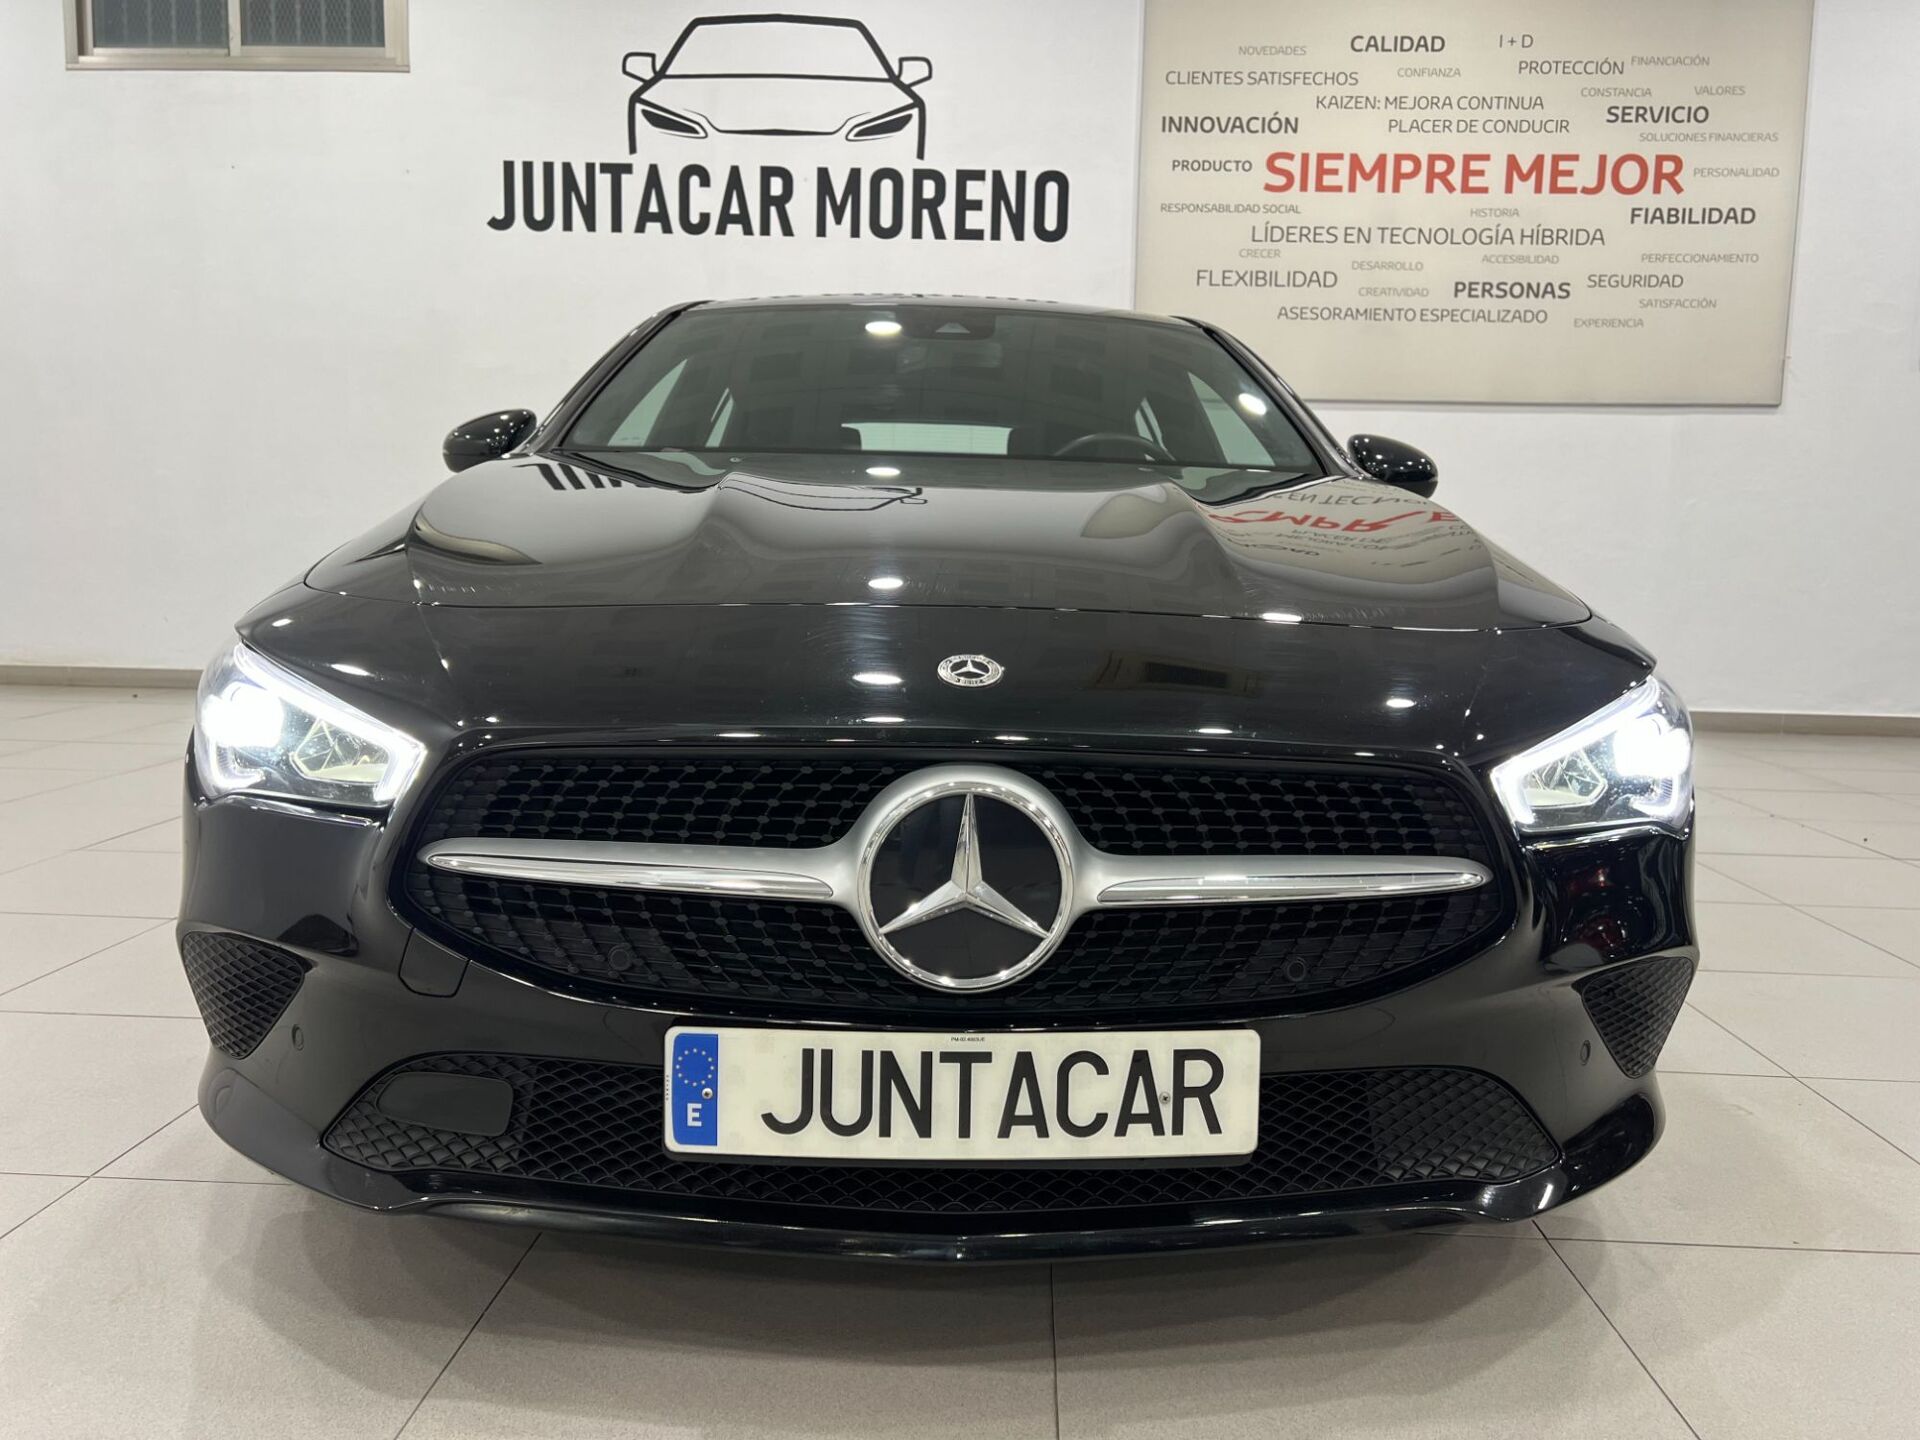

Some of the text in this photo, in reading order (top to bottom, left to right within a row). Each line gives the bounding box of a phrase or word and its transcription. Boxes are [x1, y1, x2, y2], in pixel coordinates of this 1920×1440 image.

[1350, 35, 1445, 53] CALIDAD
[1521, 34, 1533, 48] D
[1239, 45, 1306, 56] NOVEDADES
[1518, 57, 1624, 75] PROTECCIÓN
[1631, 55, 1710, 66] FINANCIACIÓN
[1166, 71, 1359, 86] CLIENTES SATISFECHOS
[1397, 67, 1461, 78] CONFIANZA
[1580, 87, 1652, 98] CONSTANCIA
[1694, 85, 1745, 96] VALORES
[1316, 95, 1544, 111] KAIZEN: MEJORA CONTINUA
[1606, 106, 1709, 124] SERVICIO
[1161, 112, 1298, 134] INNOVACIÓN
[1388, 119, 1570, 134] PLACER DE CONDUCIR
[1639, 132, 1779, 142] SOLUCIONES FINANCIERAS
[1172, 160, 1252, 172] PRODUCTO
[1693, 167, 1780, 178] PERSONALIDAD
[1263, 151, 1684, 196] SIEMPRE MEJOR
[486, 160, 1070, 243] JUNTACAR MORENO
[1160, 203, 1301, 215] RESPONSABILIDAD SOCIAL
[1470, 208, 1519, 217] HISTORIA
[1630, 207, 1756, 225] FIABILIDAD
[1251, 221, 1605, 246] LÍDERES EN TECNOLOGÍA HÍBRIDA
[1239, 249, 1281, 258] CRECER
[1481, 254, 1559, 264] ACCESIBILIDAD
[1641, 253, 1759, 263] PERFECCIONAMIENTO
[1351, 261, 1423, 271] DESARROLLO
[1196, 269, 1338, 288] FLEXIBILIDAD
[1587, 274, 1684, 289] SEGURIDAD
[1358, 287, 1429, 297] CREATIVIDAD
[1453, 281, 1571, 299] PERSONAS
[1639, 297, 1717, 309] SATISFACCIÓN
[1277, 306, 1548, 323] ASESORAMIENTO ESPECIALIZADO
[1574, 318, 1644, 329] EXPERIENCIA
[761, 1048, 1225, 1138] JUNTACAR
[687, 1103, 702, 1127] E
